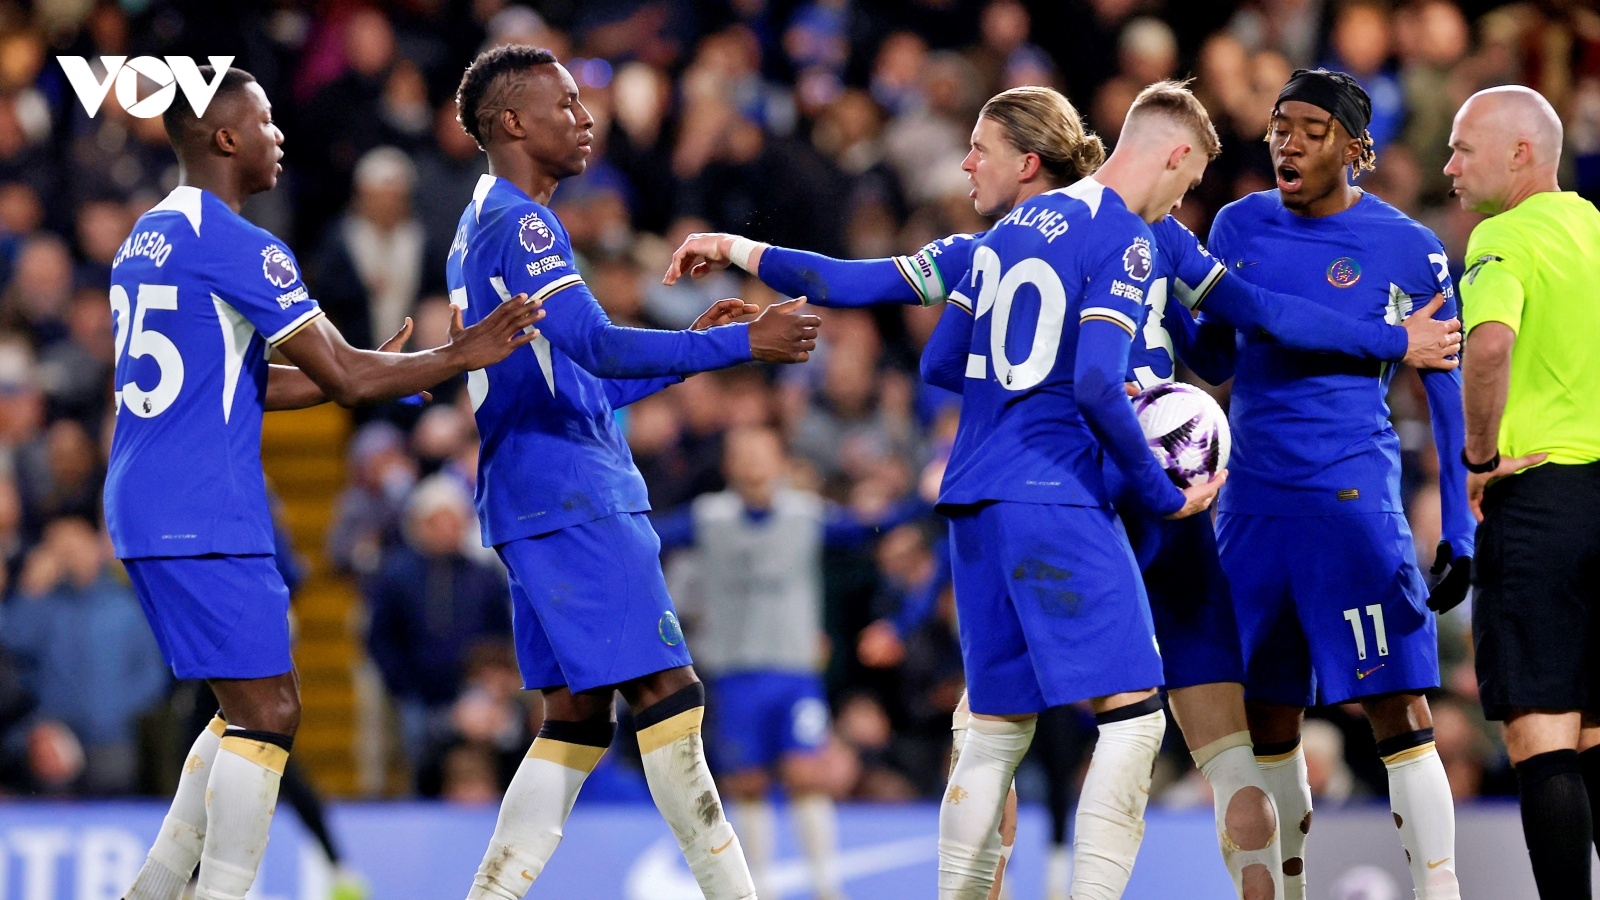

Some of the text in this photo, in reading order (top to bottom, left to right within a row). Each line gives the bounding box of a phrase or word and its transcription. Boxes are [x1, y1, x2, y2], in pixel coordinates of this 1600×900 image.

[992, 206, 1069, 244] ALMER
[526, 254, 561, 271] No room
[1112, 279, 1126, 290] No
[964, 245, 1066, 391] 20
[109, 283, 185, 419] 25
[1343, 604, 1389, 660] 11
